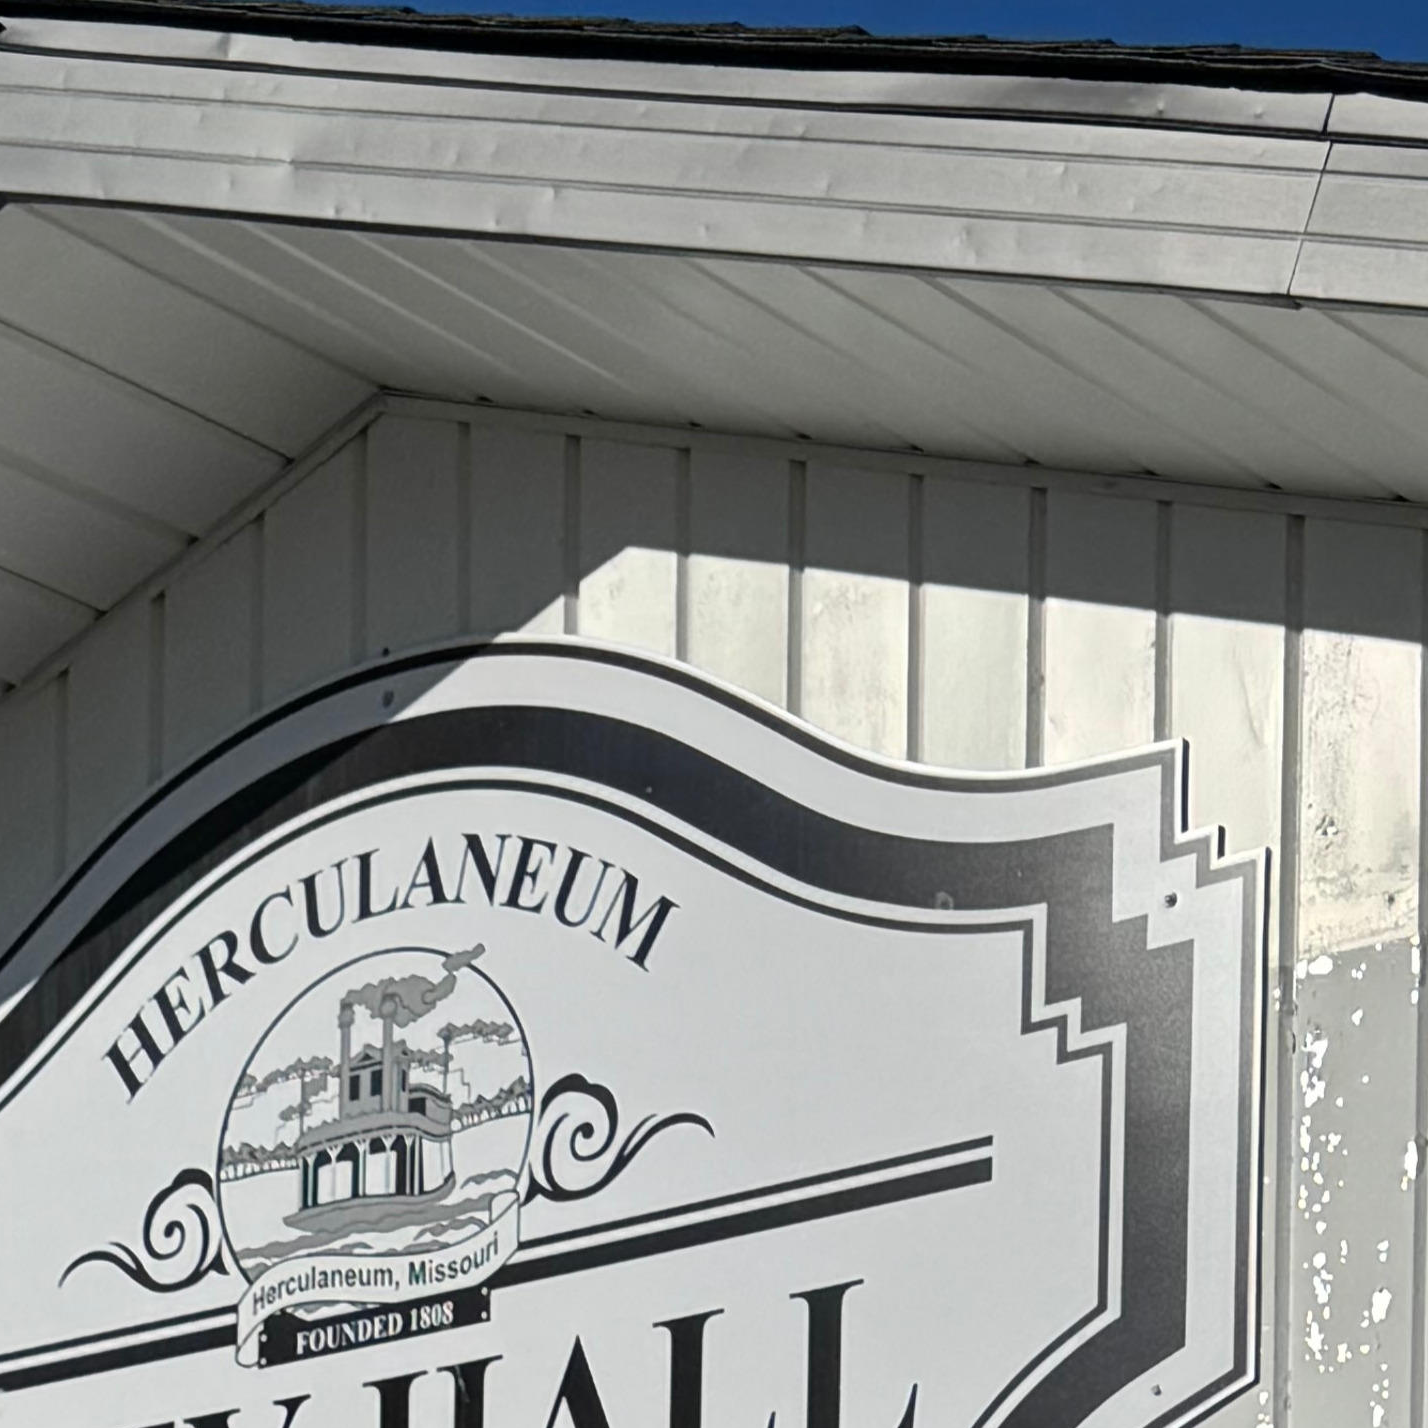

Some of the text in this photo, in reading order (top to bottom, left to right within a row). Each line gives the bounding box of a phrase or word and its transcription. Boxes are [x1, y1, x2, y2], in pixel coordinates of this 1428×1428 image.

[102, 833, 680, 1104] HERCULANEUM
[252, 1230, 499, 1315] Herculaneum, Missouri
[296, 1300, 454, 1355] FOUNDED 1808
